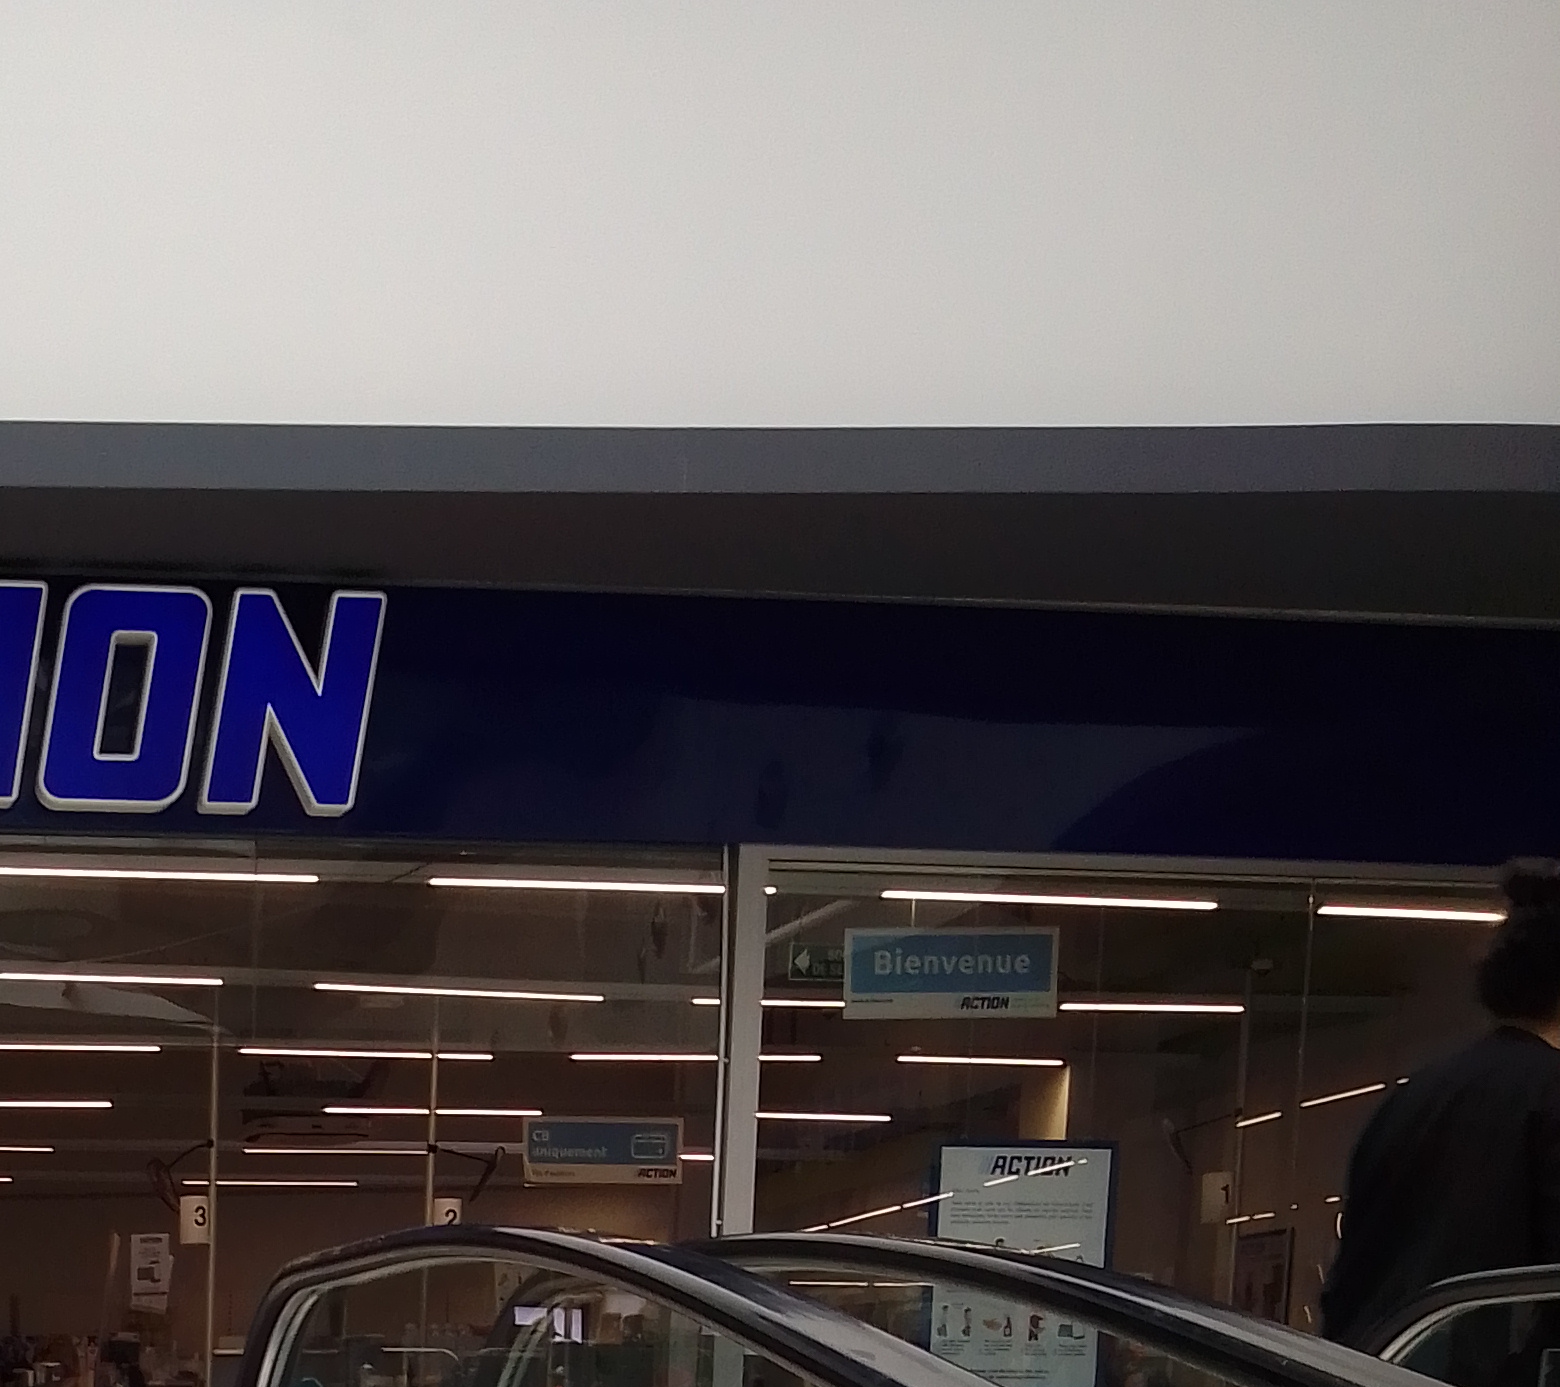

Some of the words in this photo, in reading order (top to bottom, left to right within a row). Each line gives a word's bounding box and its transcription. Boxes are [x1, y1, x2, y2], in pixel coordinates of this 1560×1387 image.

[874, 947, 1031, 975] Bienvenue
[961, 996, 1010, 1010] ACTION
[532, 1145, 608, 1159] uniquement
[638, 1167, 677, 1179] ACTION
[991, 1155, 1073, 1177] ACTION
[1221, 1184, 1230, 1204] 1
[194, 1205, 207, 1228] 3
[445, 1208, 458, 1225] 2
